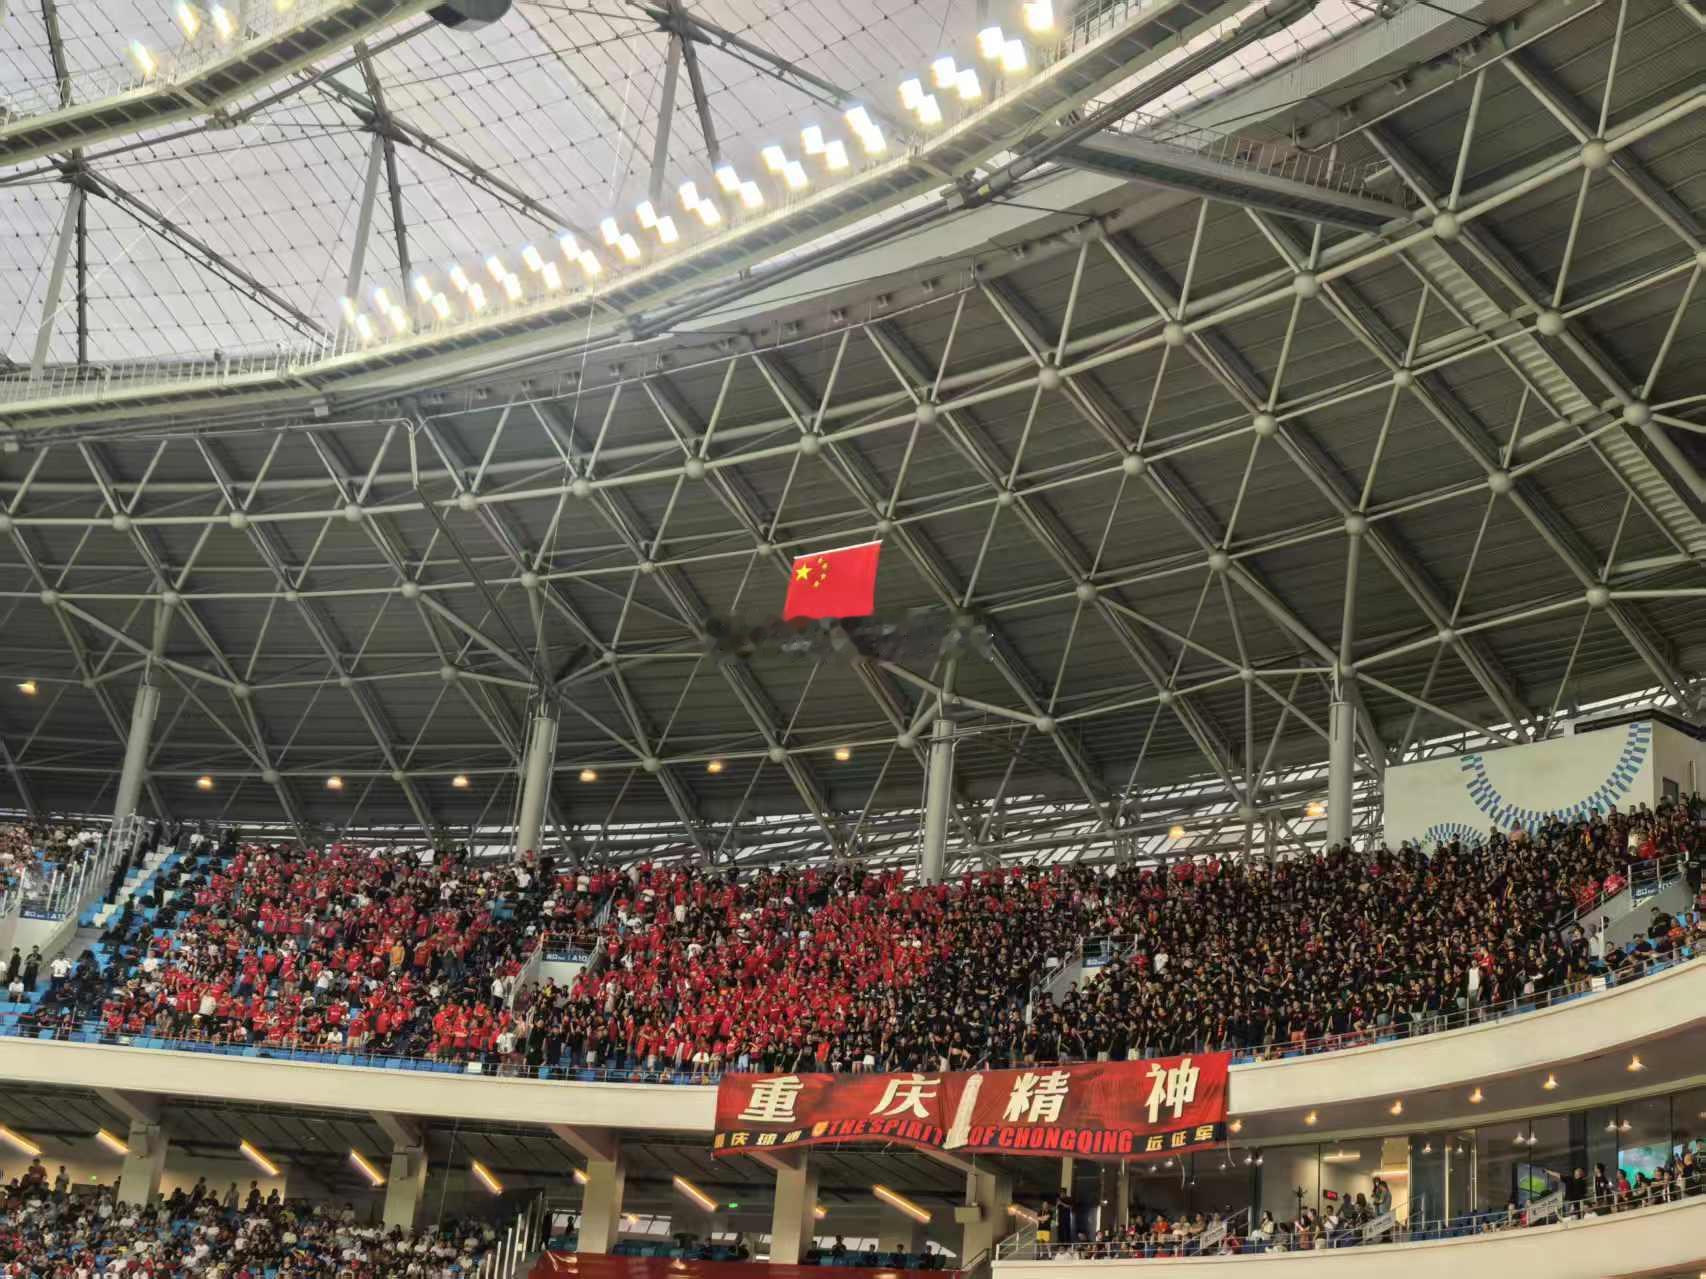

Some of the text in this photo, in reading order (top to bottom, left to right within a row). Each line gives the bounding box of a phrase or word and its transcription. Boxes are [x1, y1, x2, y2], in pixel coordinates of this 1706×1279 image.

[828, 1119, 866, 1136] THE
[968, 1125, 999, 1146] OF
[1000, 1126, 1134, 1153] CHONGQING
[1145, 1125, 1214, 1152] 远征军
